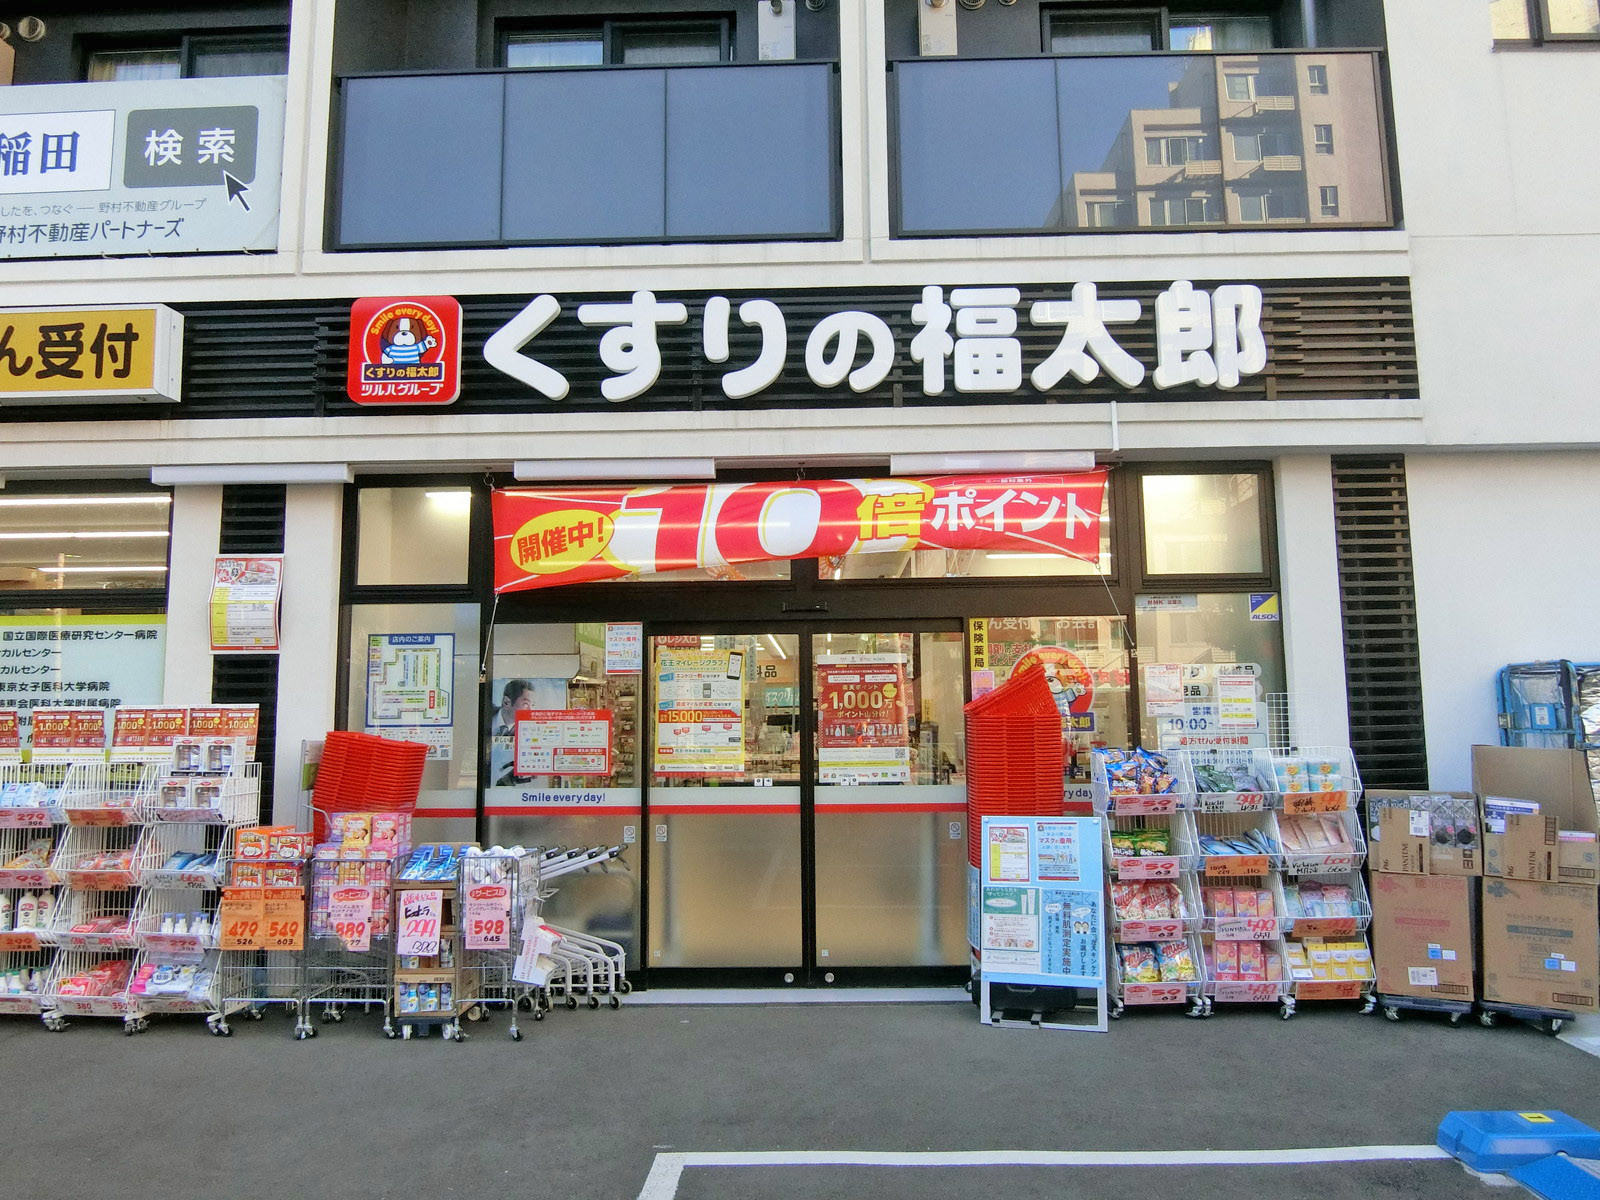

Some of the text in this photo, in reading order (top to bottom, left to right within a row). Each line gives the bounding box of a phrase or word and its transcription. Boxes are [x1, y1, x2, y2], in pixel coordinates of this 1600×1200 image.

[145, 127, 236, 166] 検索
[98, 198, 207, 214] 野村不動産グループ
[370, 307, 440, 335] Smile every day!
[483, 280, 1267, 402] くすりの福太郎
[365, 366, 439, 378] くすりの福太郎
[361, 383, 444, 396] ツルハグループ
[517, 516, 604, 566] 開催中!
[3, 630, 158, 642] 国立国際医療研究センター病院
[973, 620, 985, 668] 保険薬局
[0, 648, 62, 658] カルセンター
[0, 665, 61, 675] カルセンター
[521, 792, 606, 804] Smile every day!
[17, 812, 46, 821] 279
[1401, 842, 1409, 872] PANTENE
[1528, 850, 1536, 879] PANTENE
[228, 921, 259, 937] 479
[269, 921, 299, 937] 549
[335, 921, 366, 938] 889
[474, 919, 505, 935] 598
[1062, 902, 1072, 975] 無料肌測定実施中
